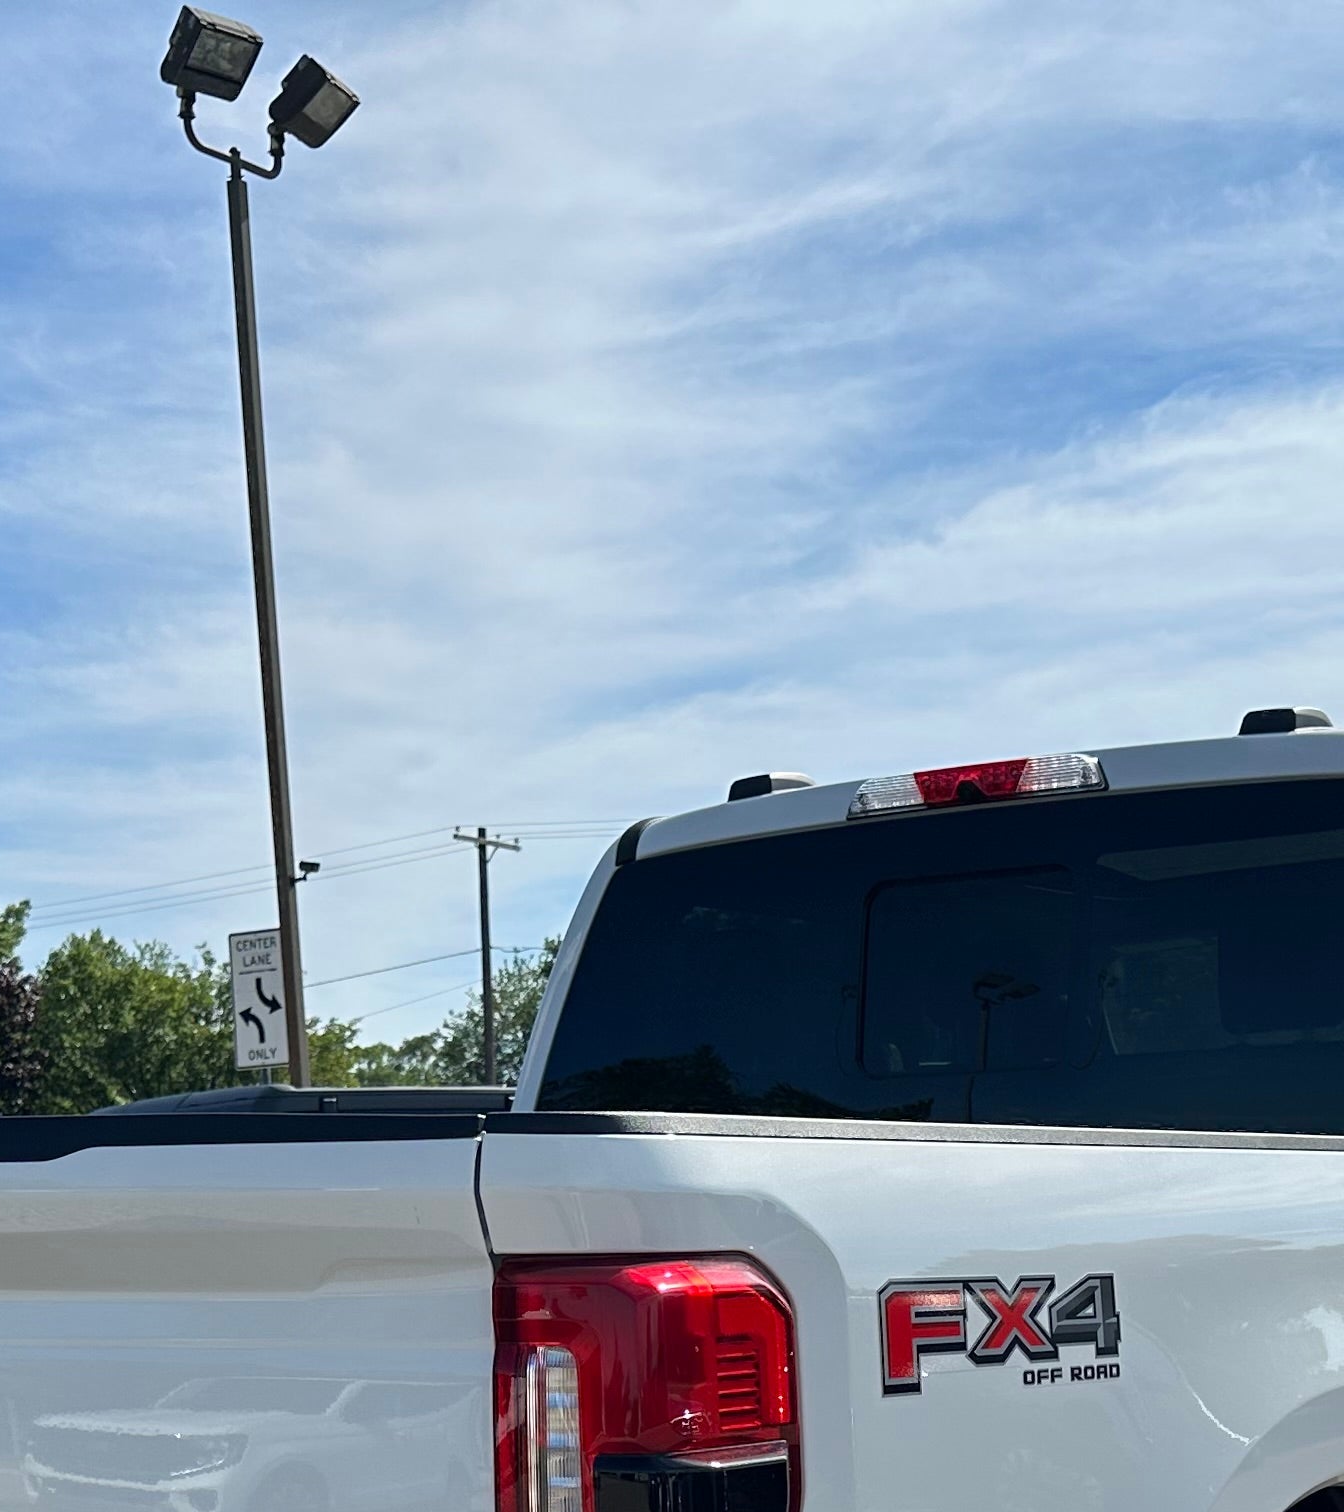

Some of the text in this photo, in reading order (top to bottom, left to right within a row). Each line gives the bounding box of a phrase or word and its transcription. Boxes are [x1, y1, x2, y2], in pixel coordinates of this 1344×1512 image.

[236, 936, 277, 953] CENTER
[242, 953, 272, 968] LANE
[248, 1047, 277, 1061] ONLY
[877, 1273, 1121, 1397] FX4
[1023, 1363, 1121, 1386] OFF ROAD
